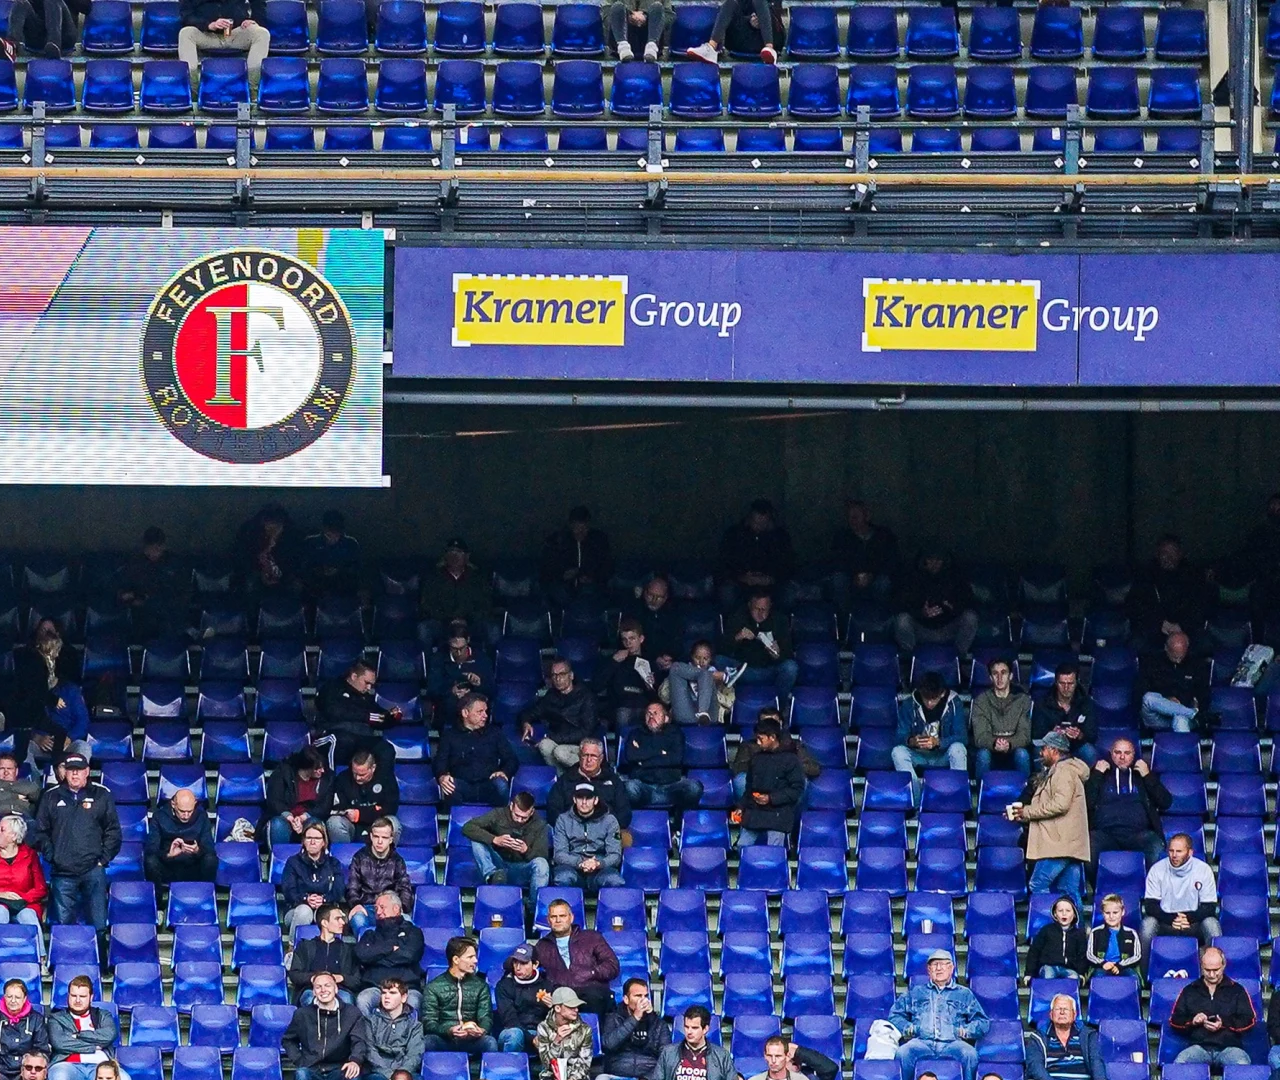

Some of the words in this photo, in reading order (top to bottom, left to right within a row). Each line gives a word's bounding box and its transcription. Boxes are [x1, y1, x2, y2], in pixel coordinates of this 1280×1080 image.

[156, 256, 340, 326] FEYENOORD
[462, 290, 617, 325] Kramer
[629, 294, 742, 338] Group
[872, 295, 1029, 330] Kramer
[1041, 298, 1159, 342] Group
[204, 306, 286, 407] F
